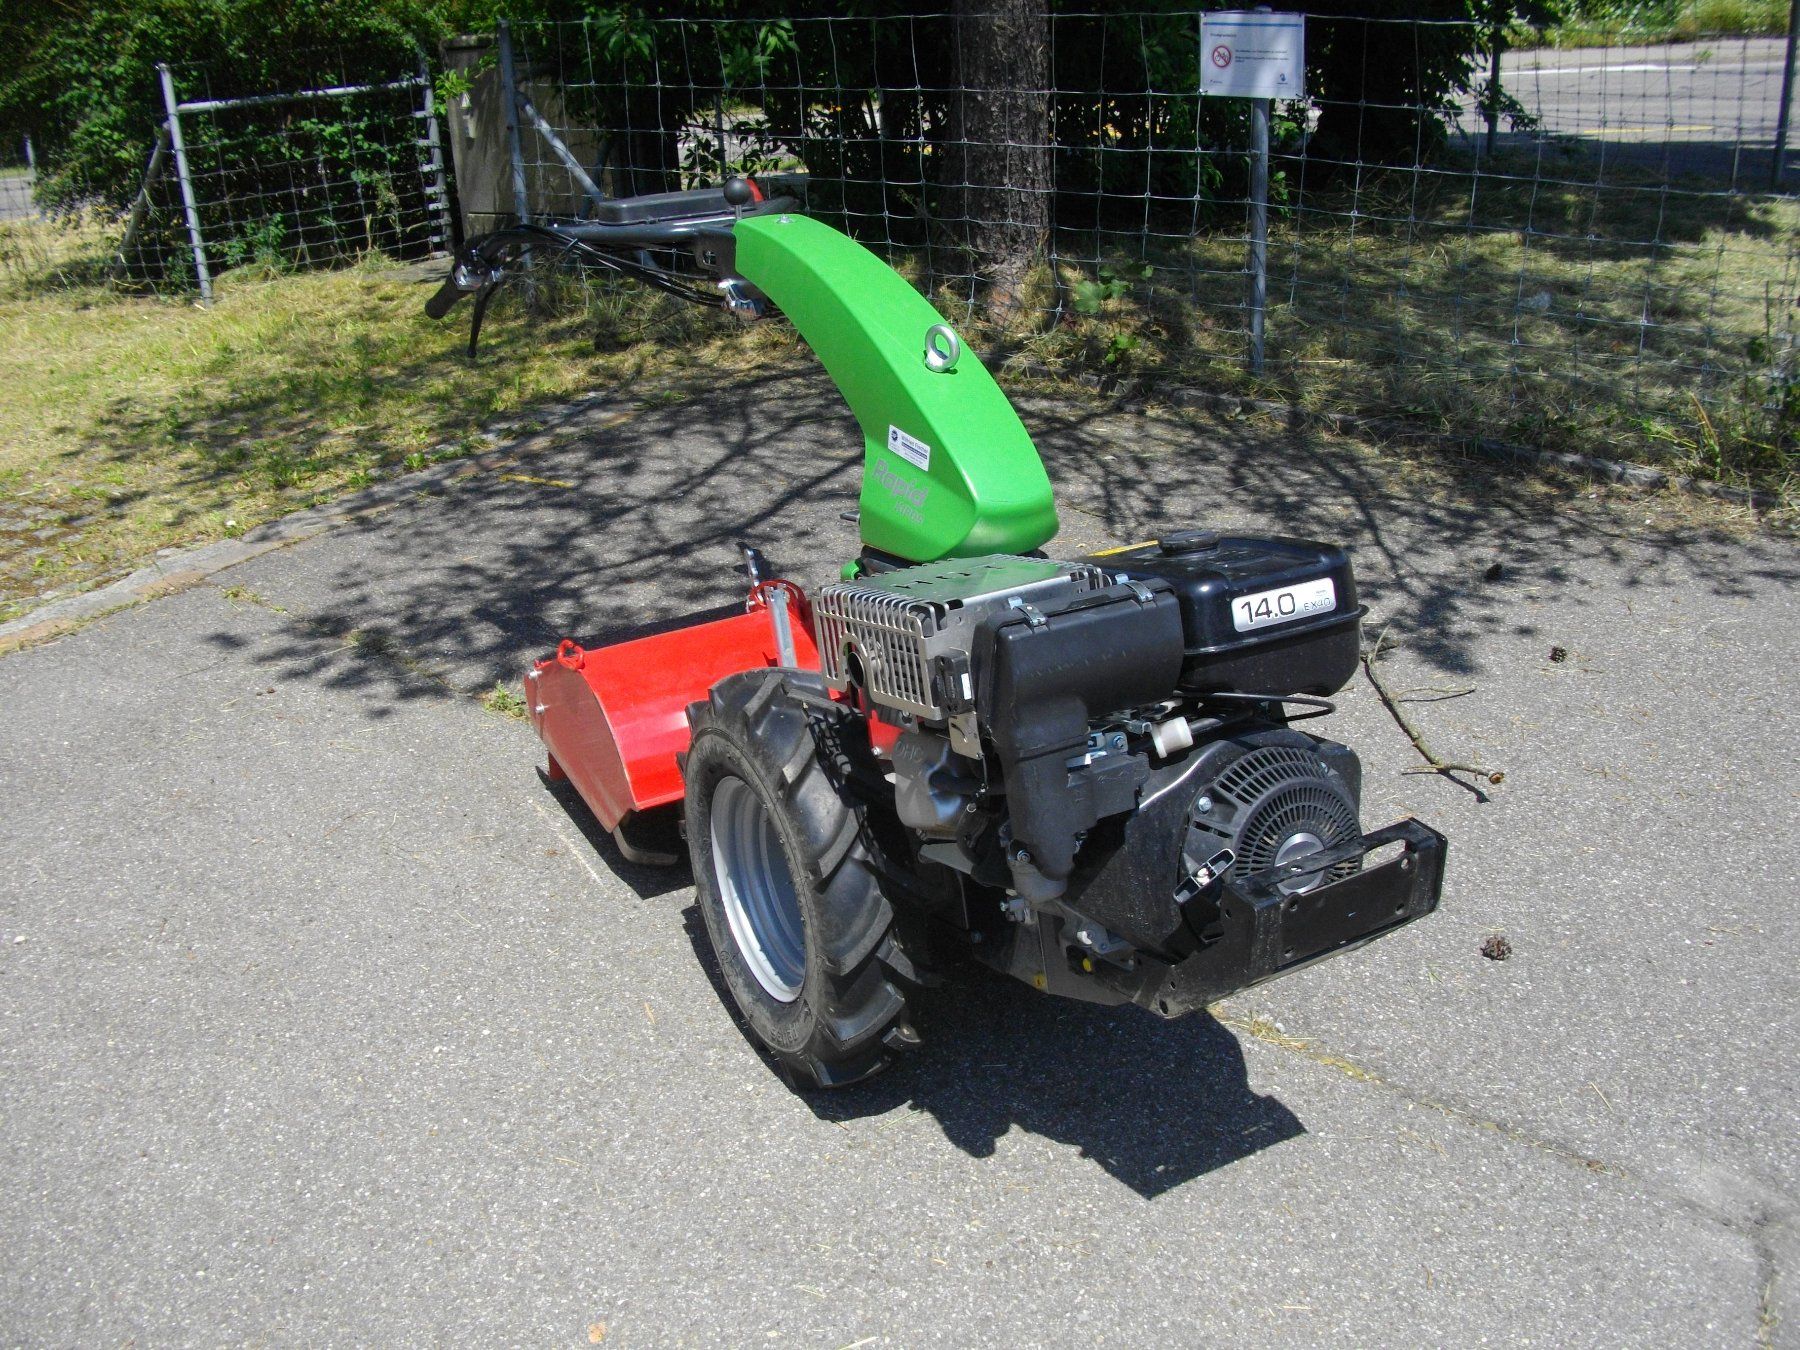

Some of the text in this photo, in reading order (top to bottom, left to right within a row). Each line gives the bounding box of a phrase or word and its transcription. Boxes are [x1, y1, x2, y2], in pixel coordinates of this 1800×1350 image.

[873, 459, 928, 507] Rapid
[1241, 593, 1331, 623] 14.0 EX40
